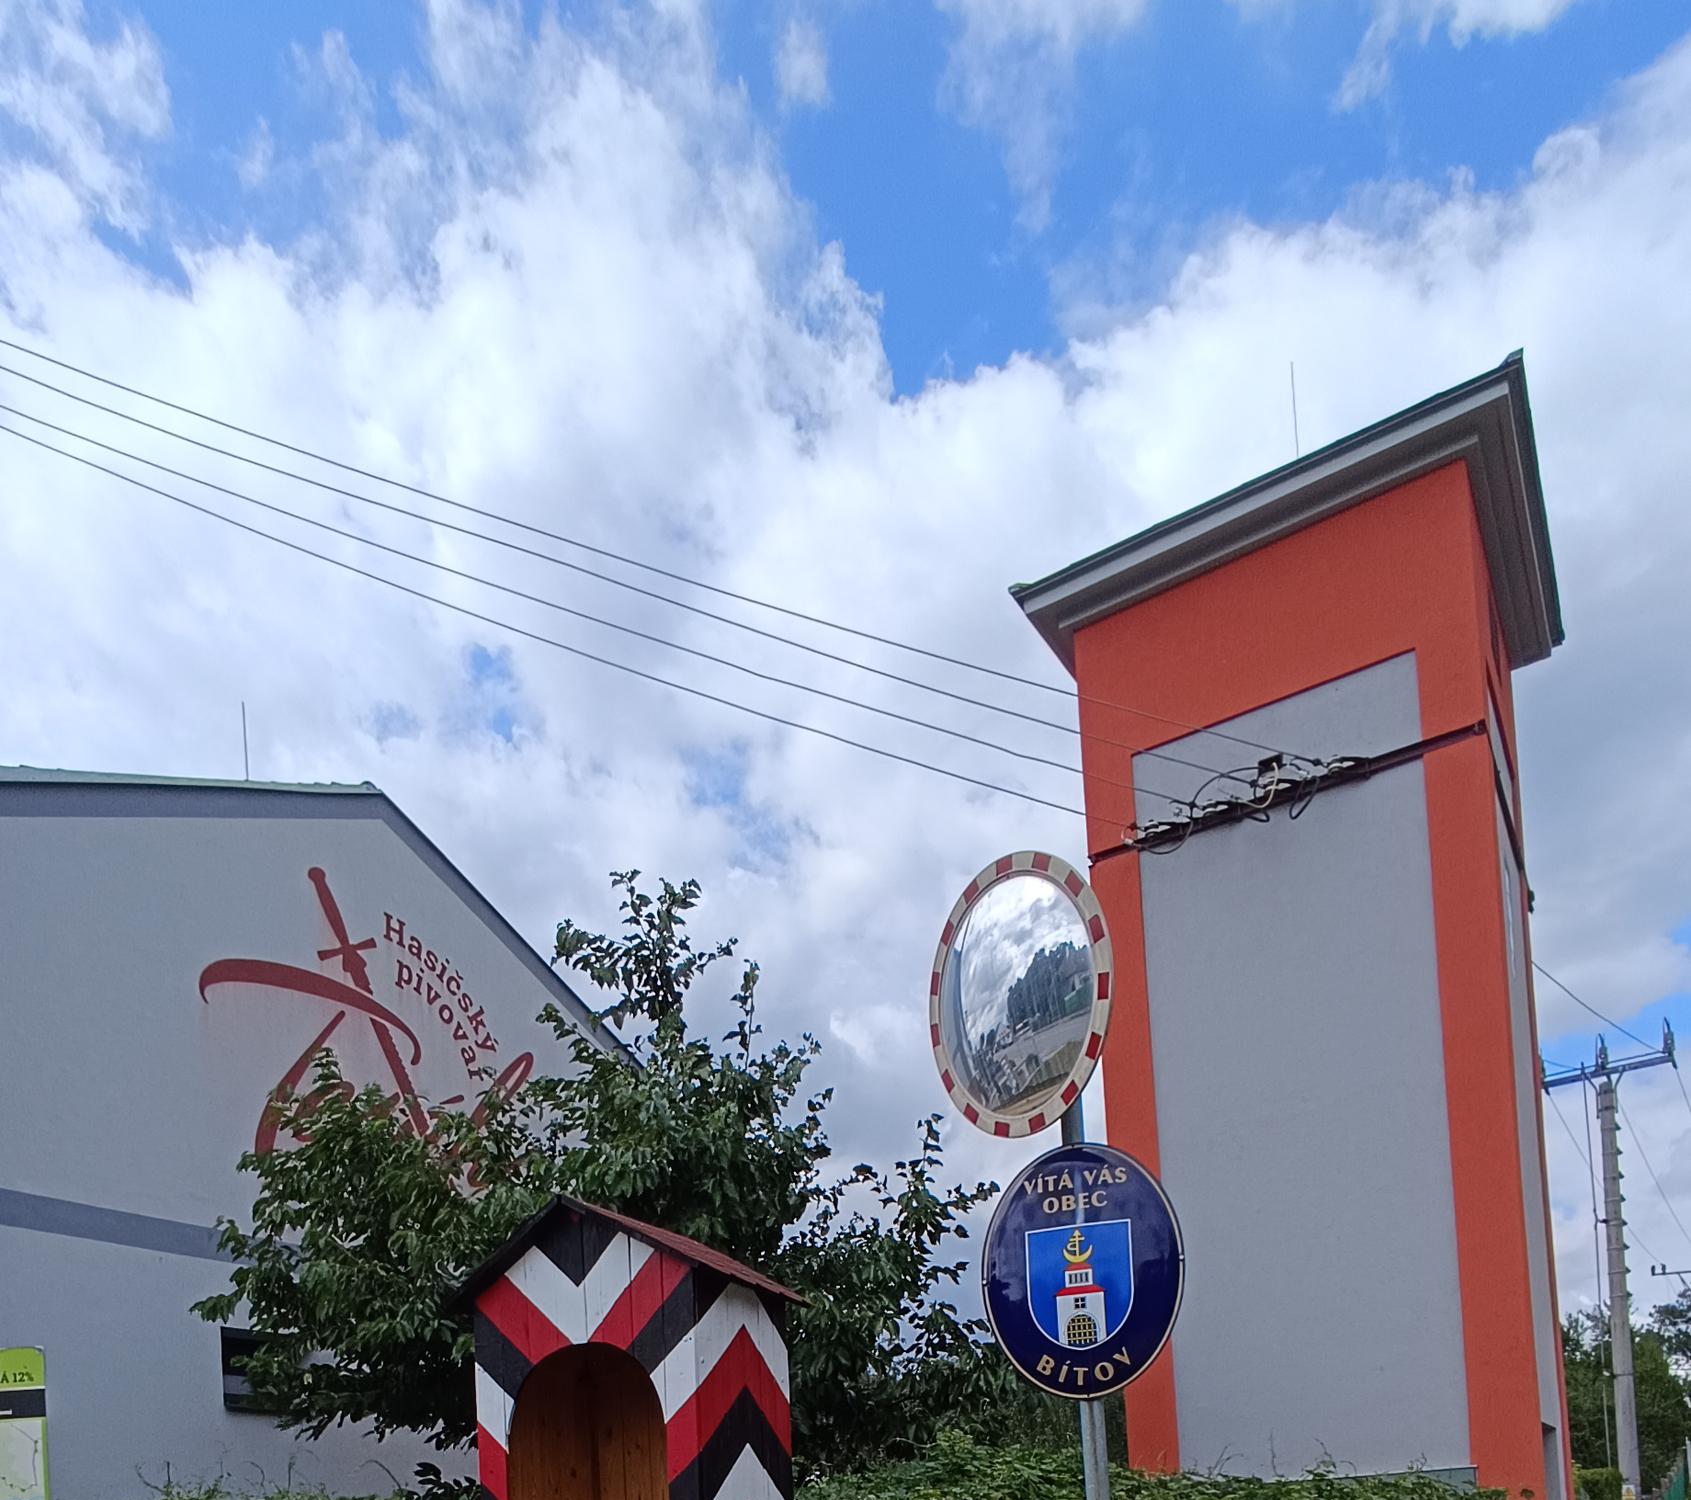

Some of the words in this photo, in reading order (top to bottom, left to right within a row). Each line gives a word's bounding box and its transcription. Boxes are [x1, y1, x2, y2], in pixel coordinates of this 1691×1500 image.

[383, 912, 499, 1052] Hasičský
[395, 959, 484, 1082] pivovar
[1023, 1169, 1074, 1195] VÍTÁ
[1083, 1164, 1128, 1186] VÁS
[1042, 1191, 1108, 1215] OBEC
[1036, 1346, 1133, 1386] BÍTOV
